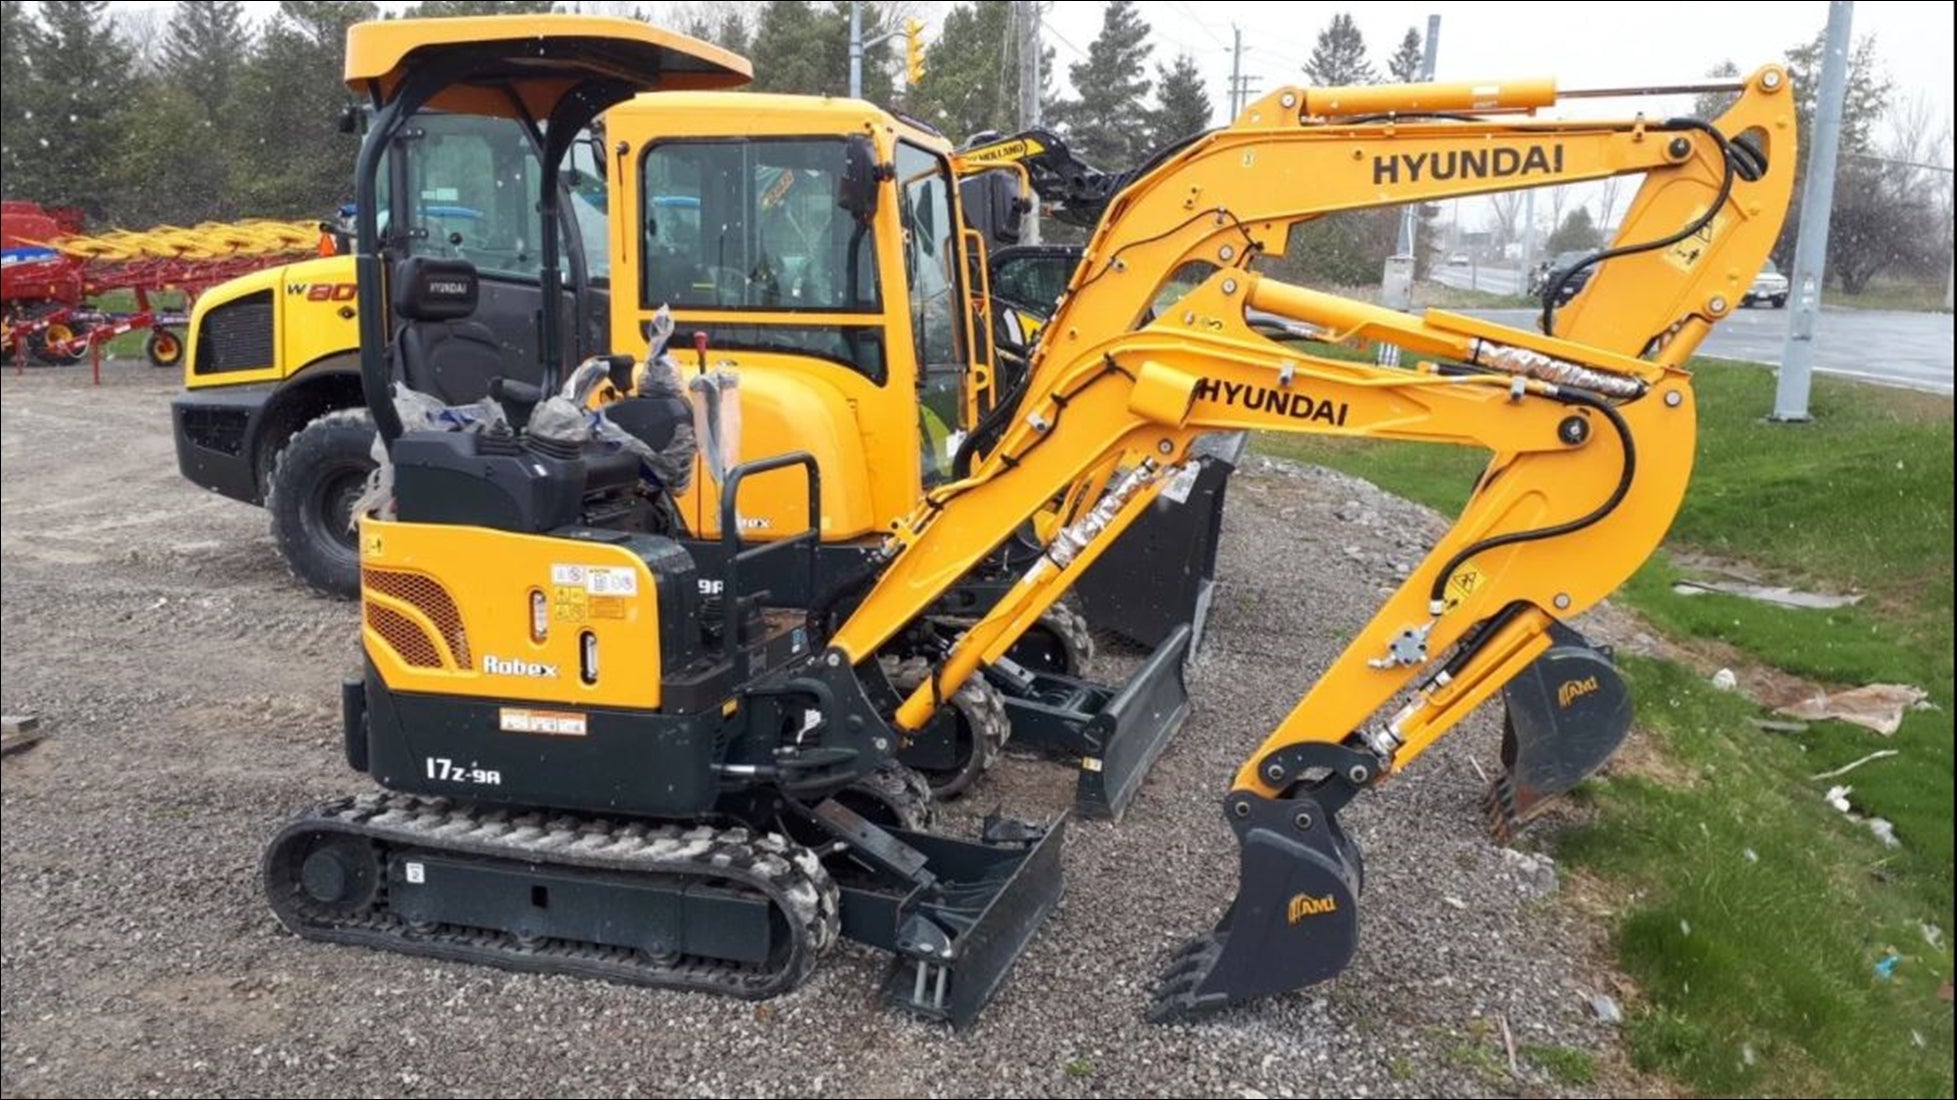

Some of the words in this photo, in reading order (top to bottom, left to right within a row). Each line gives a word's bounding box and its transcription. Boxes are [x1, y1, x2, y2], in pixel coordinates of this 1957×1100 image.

[1373, 144, 1564, 185] HYUNDAI
[429, 282, 468, 294] HYUNDAI
[1199, 378, 1348, 427] HYUNDAI
[483, 654, 558, 677] Robex
